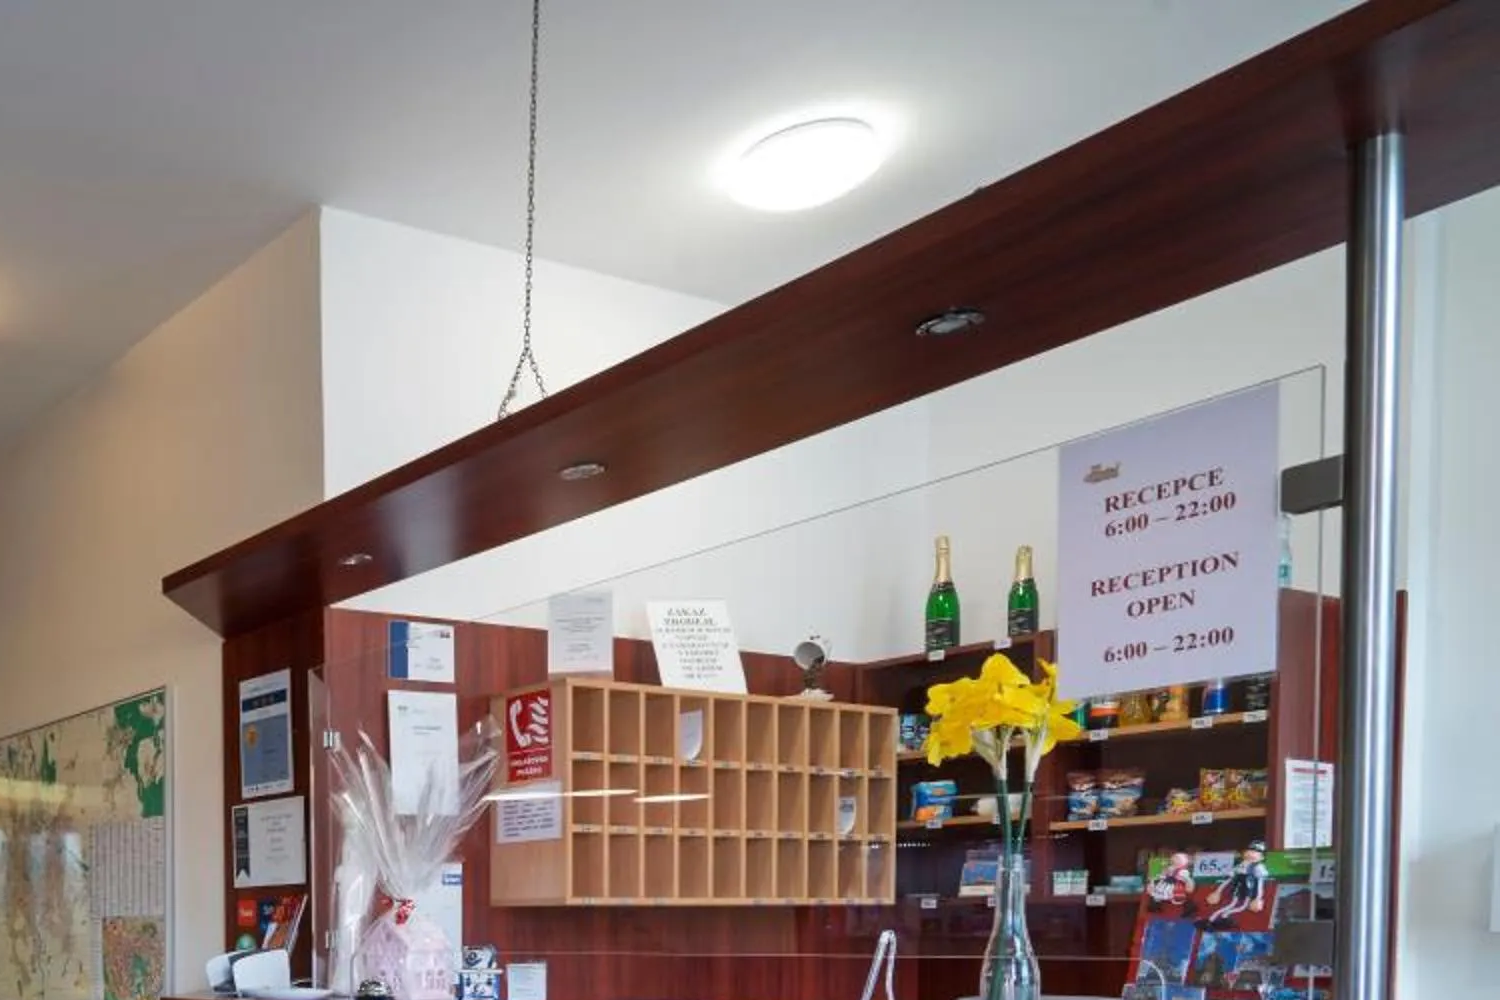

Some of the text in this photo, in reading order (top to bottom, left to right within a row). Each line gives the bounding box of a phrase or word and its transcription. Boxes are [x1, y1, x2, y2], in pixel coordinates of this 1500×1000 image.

[1104, 466, 1225, 514] RECEPCE
[1104, 513, 1149, 538] 6:00
[1174, 491, 1237, 521] 22:00
[1090, 551, 1241, 598] RECEPTION
[1126, 589, 1197, 618] OPEN
[1103, 640, 1148, 664] 6:00
[1172, 626, 1235, 653] 22:00
